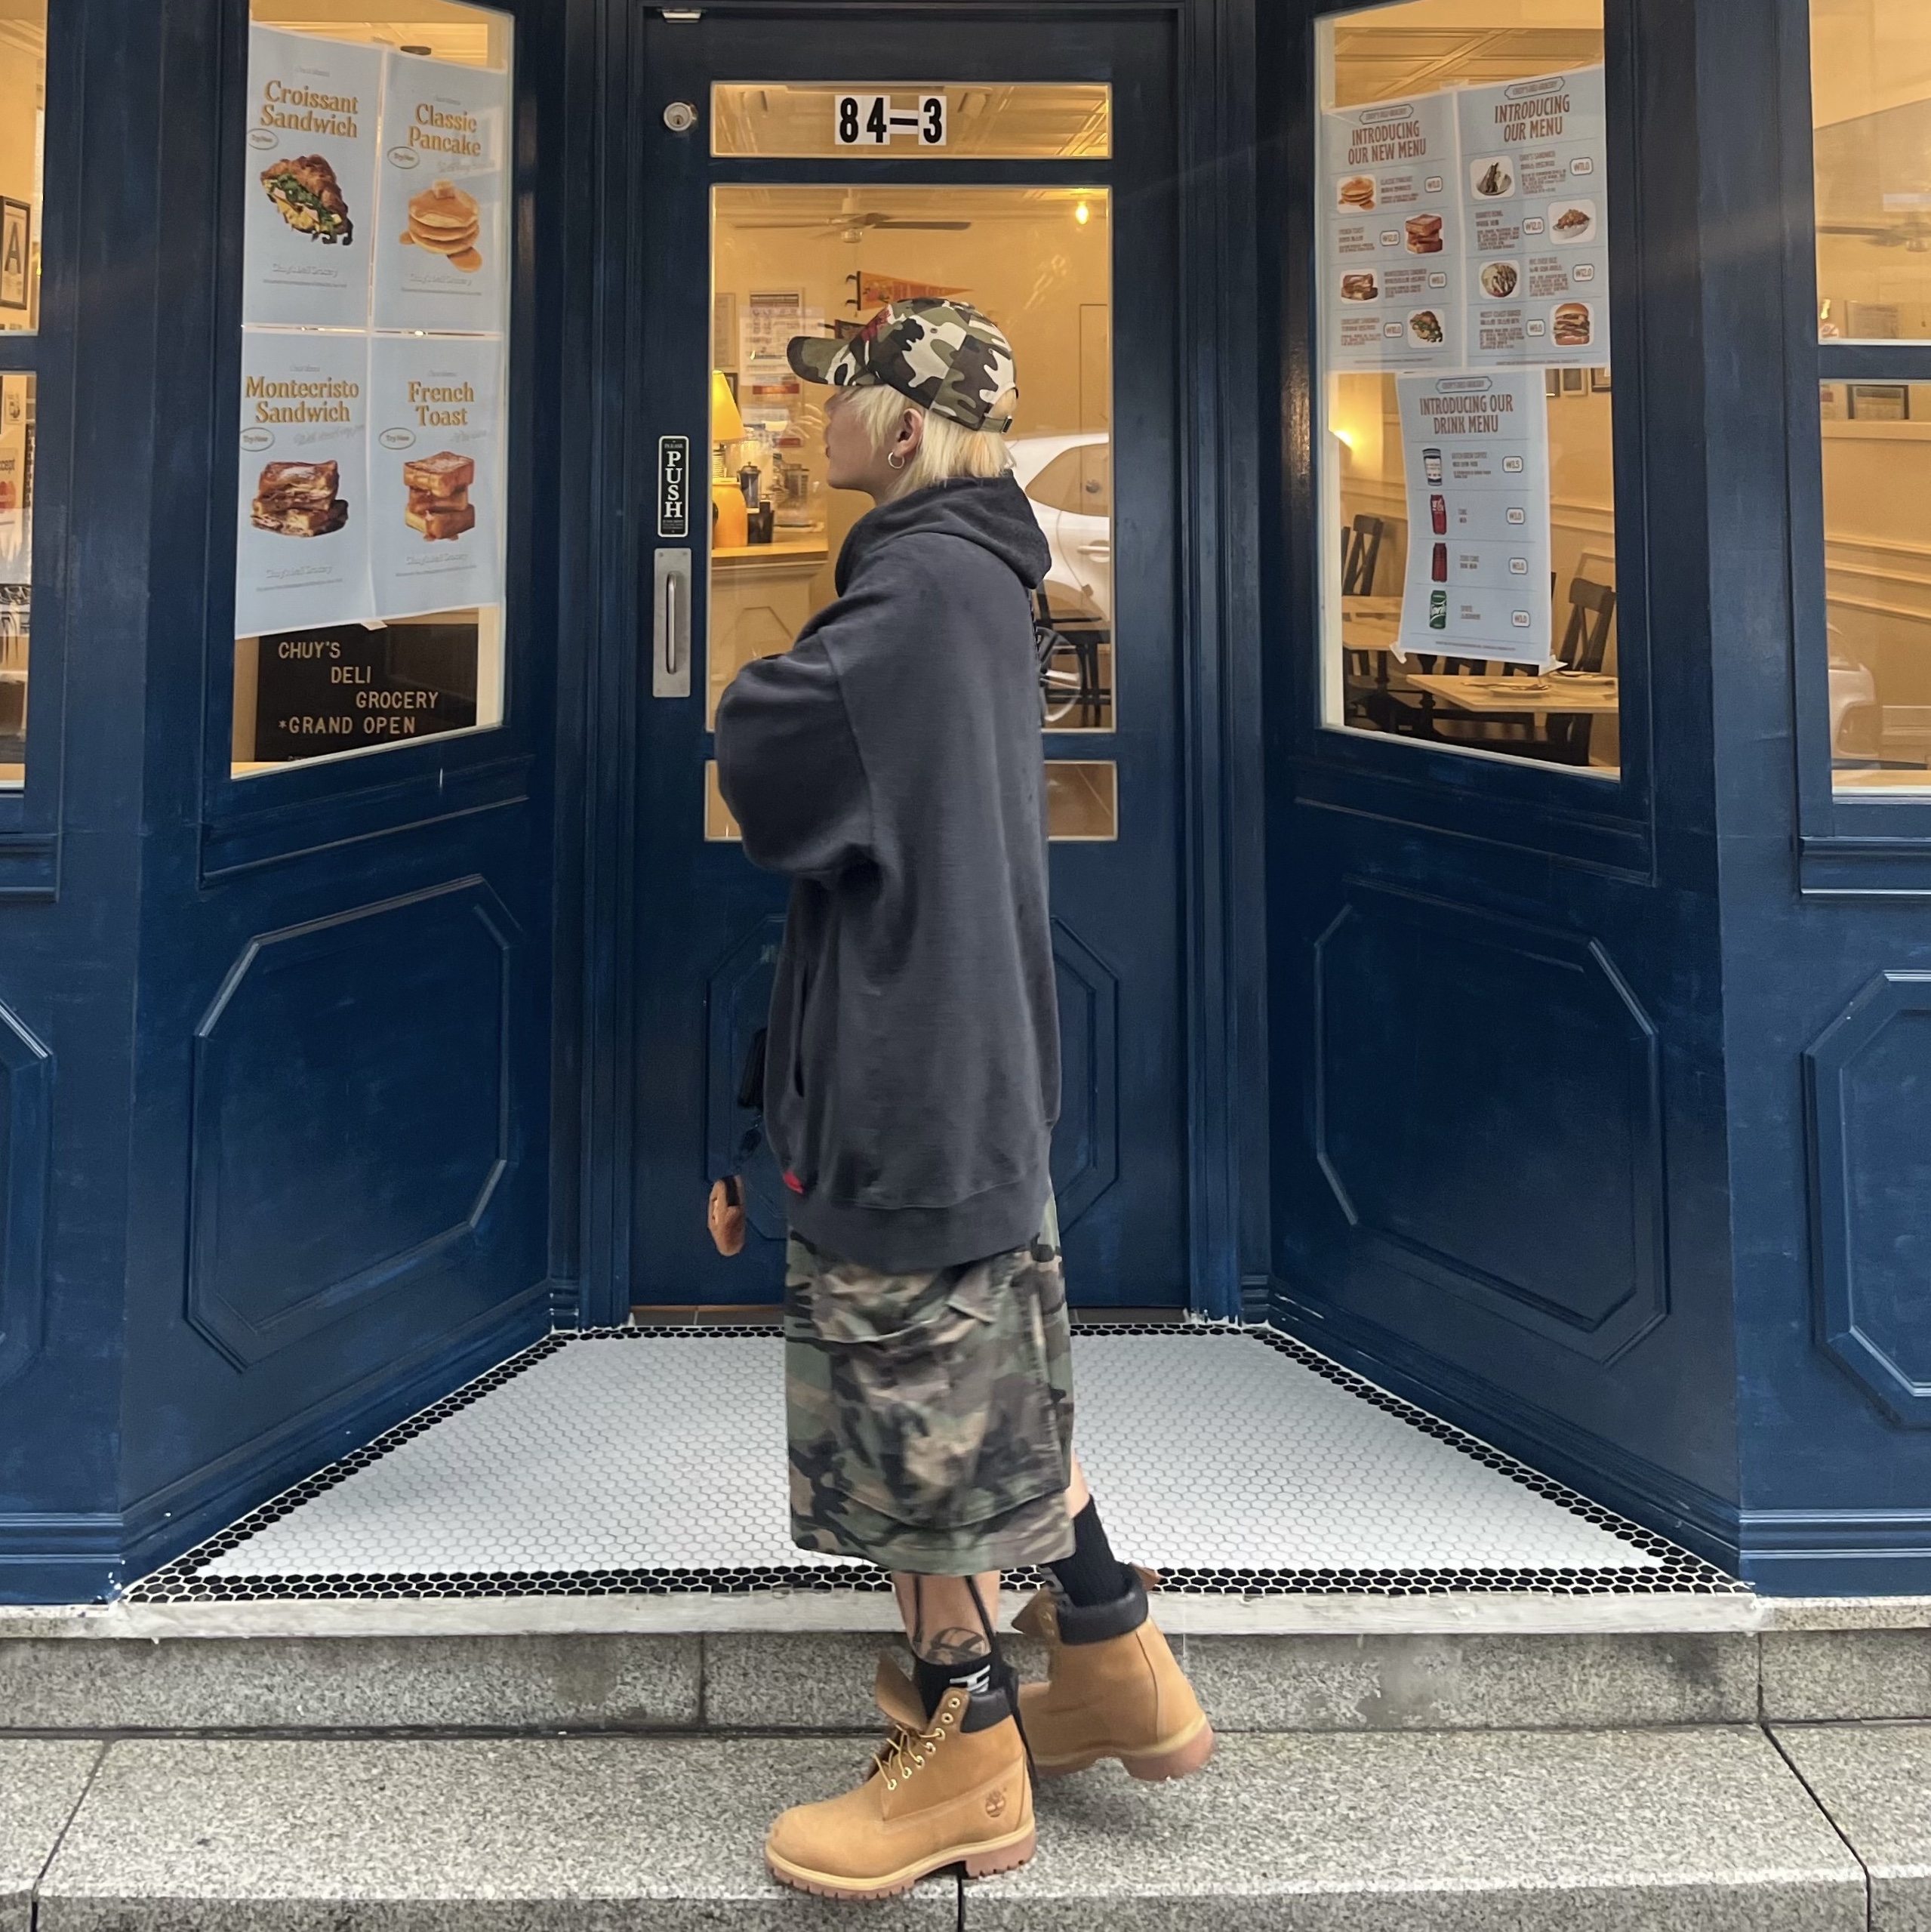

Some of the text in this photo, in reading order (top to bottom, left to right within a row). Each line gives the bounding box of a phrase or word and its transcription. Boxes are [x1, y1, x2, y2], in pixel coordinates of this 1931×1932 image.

[266, 80, 359, 114] Croissant
[1492, 94, 1571, 124] INTRODUCING
[260, 105, 358, 138] Sandwich
[416, 103, 477, 133] Classic
[839, 97, 942, 143] 84-3
[1504, 116, 1563, 143] OUR MENU
[408, 125, 482, 157] Pancake
[1352, 120, 1420, 146] INTRODUCING
[1348, 137, 1427, 165] OUR NEW MENU
[245, 376, 359, 399] Montecristo
[408, 381, 474, 403] French
[255, 401, 350, 424] Sandwich
[417, 405, 468, 427] Toast
[1419, 394, 1514, 416] INTRODUCING OUR
[1434, 414, 1498, 435] DRINK MENU
[664, 451, 683, 518] PUSH
[278, 641, 341, 659] CHUY'S
[331, 666, 371, 684] DELI
[356, 691, 439, 709] GROCERY
[363, 716, 416, 735] OPEN
